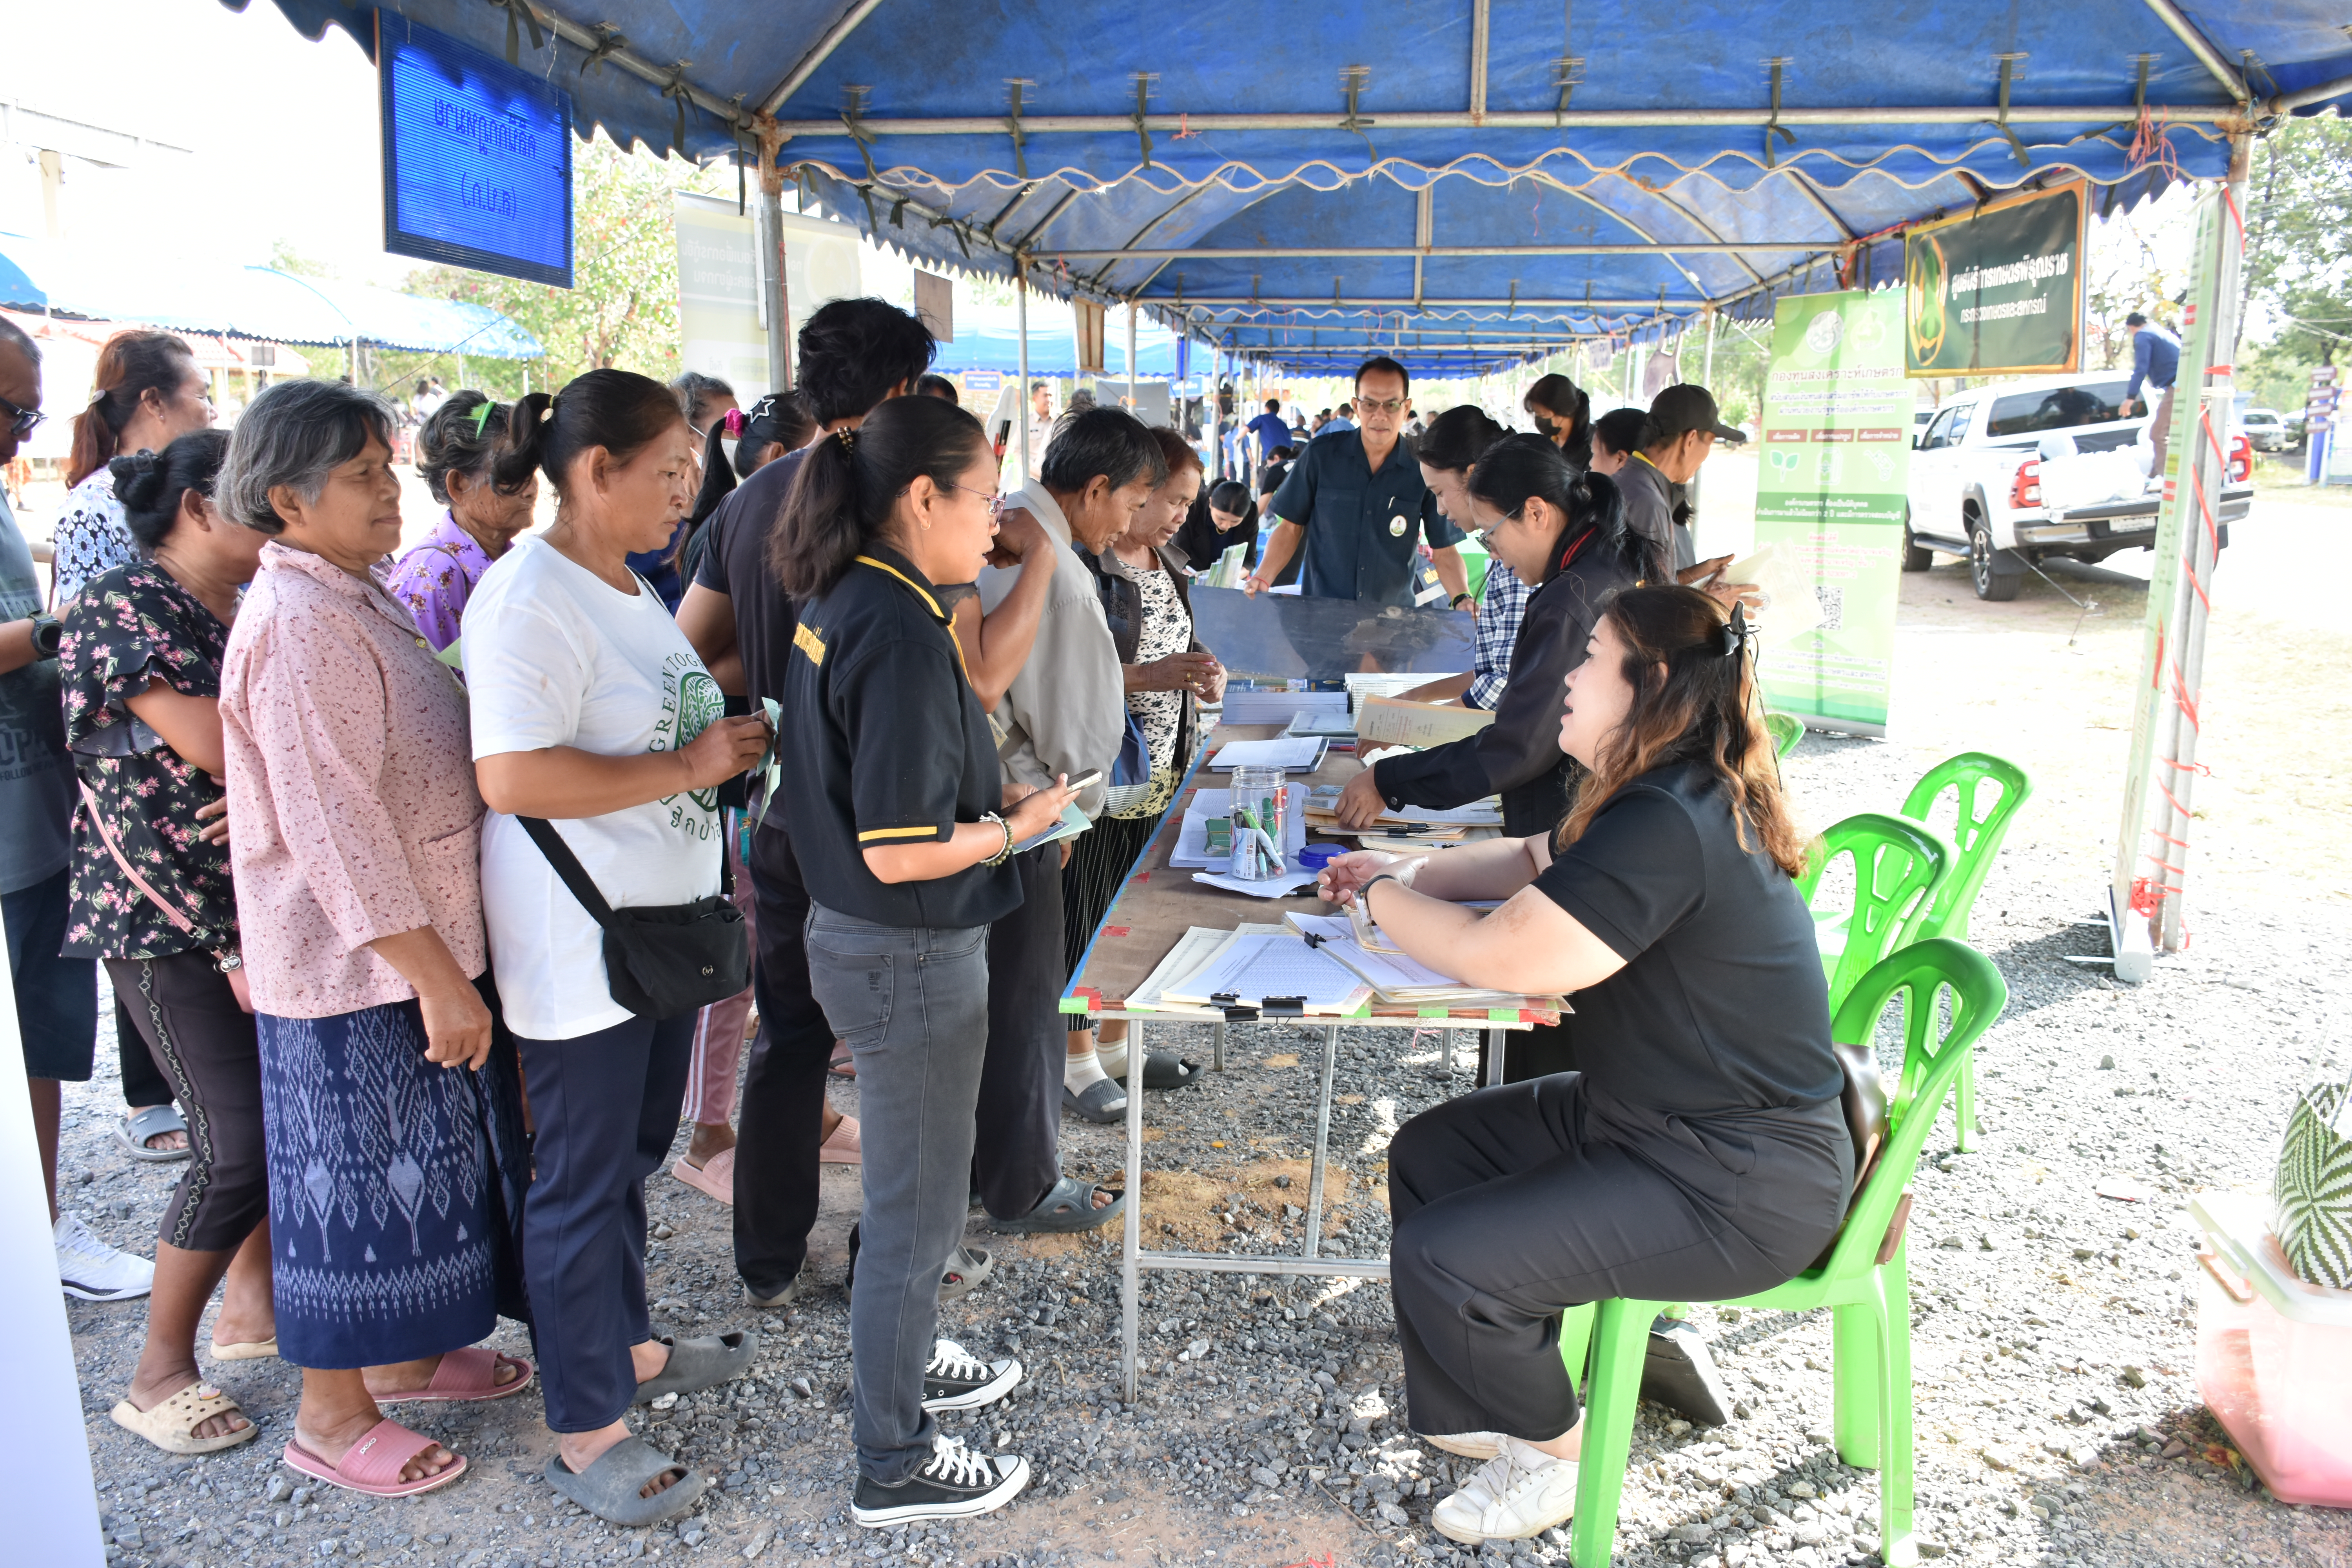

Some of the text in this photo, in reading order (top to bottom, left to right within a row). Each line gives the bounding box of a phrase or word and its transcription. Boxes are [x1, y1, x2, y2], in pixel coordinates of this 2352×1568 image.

[1960, 292, 2047, 323] กระทรวงเกษตรและสหกรณ์
[1773, 365, 1903, 385] กองทุนสงเคราะห์เกษตรก
[649, 665, 677, 753] GREEN
